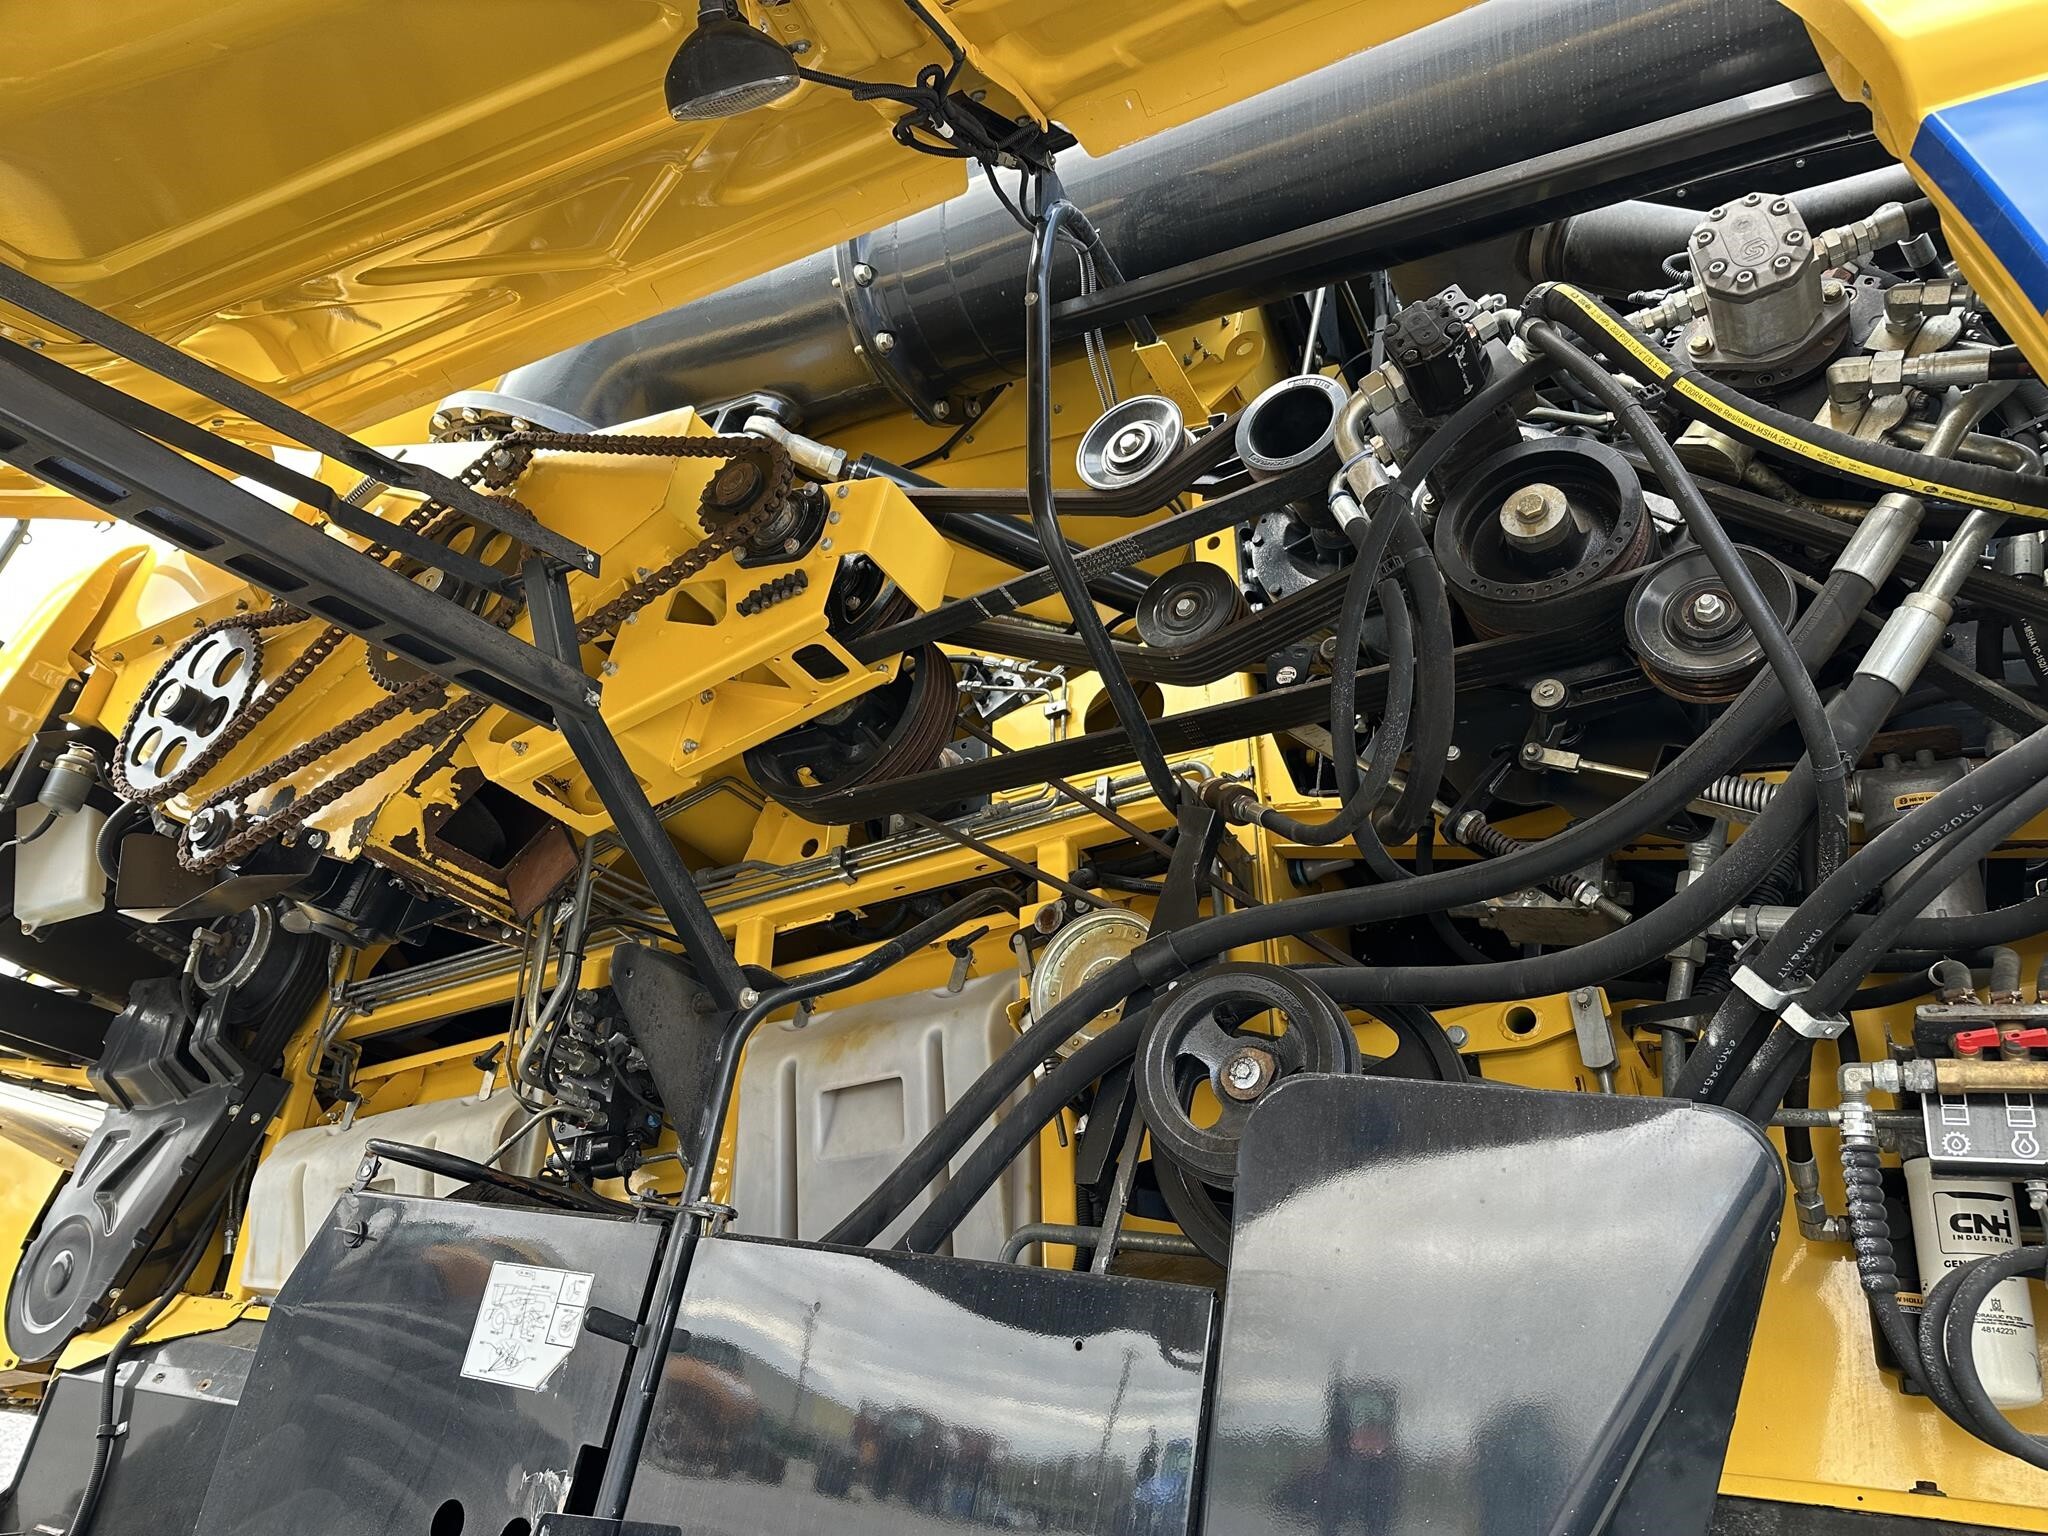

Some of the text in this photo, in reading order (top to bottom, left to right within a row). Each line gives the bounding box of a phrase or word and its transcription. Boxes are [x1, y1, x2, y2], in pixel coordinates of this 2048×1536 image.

[1703, 396, 1723, 413] Flame
[1723, 409, 1756, 431] Resistant
[1757, 426, 1778, 441] MSHA
[1778, 437, 1809, 453] 2G-11C
[2024, 626, 2037, 646] MSHA
[1952, 1234, 2013, 1245] INDUSTRIAL
[1981, 1325, 2018, 1336] 48142231
